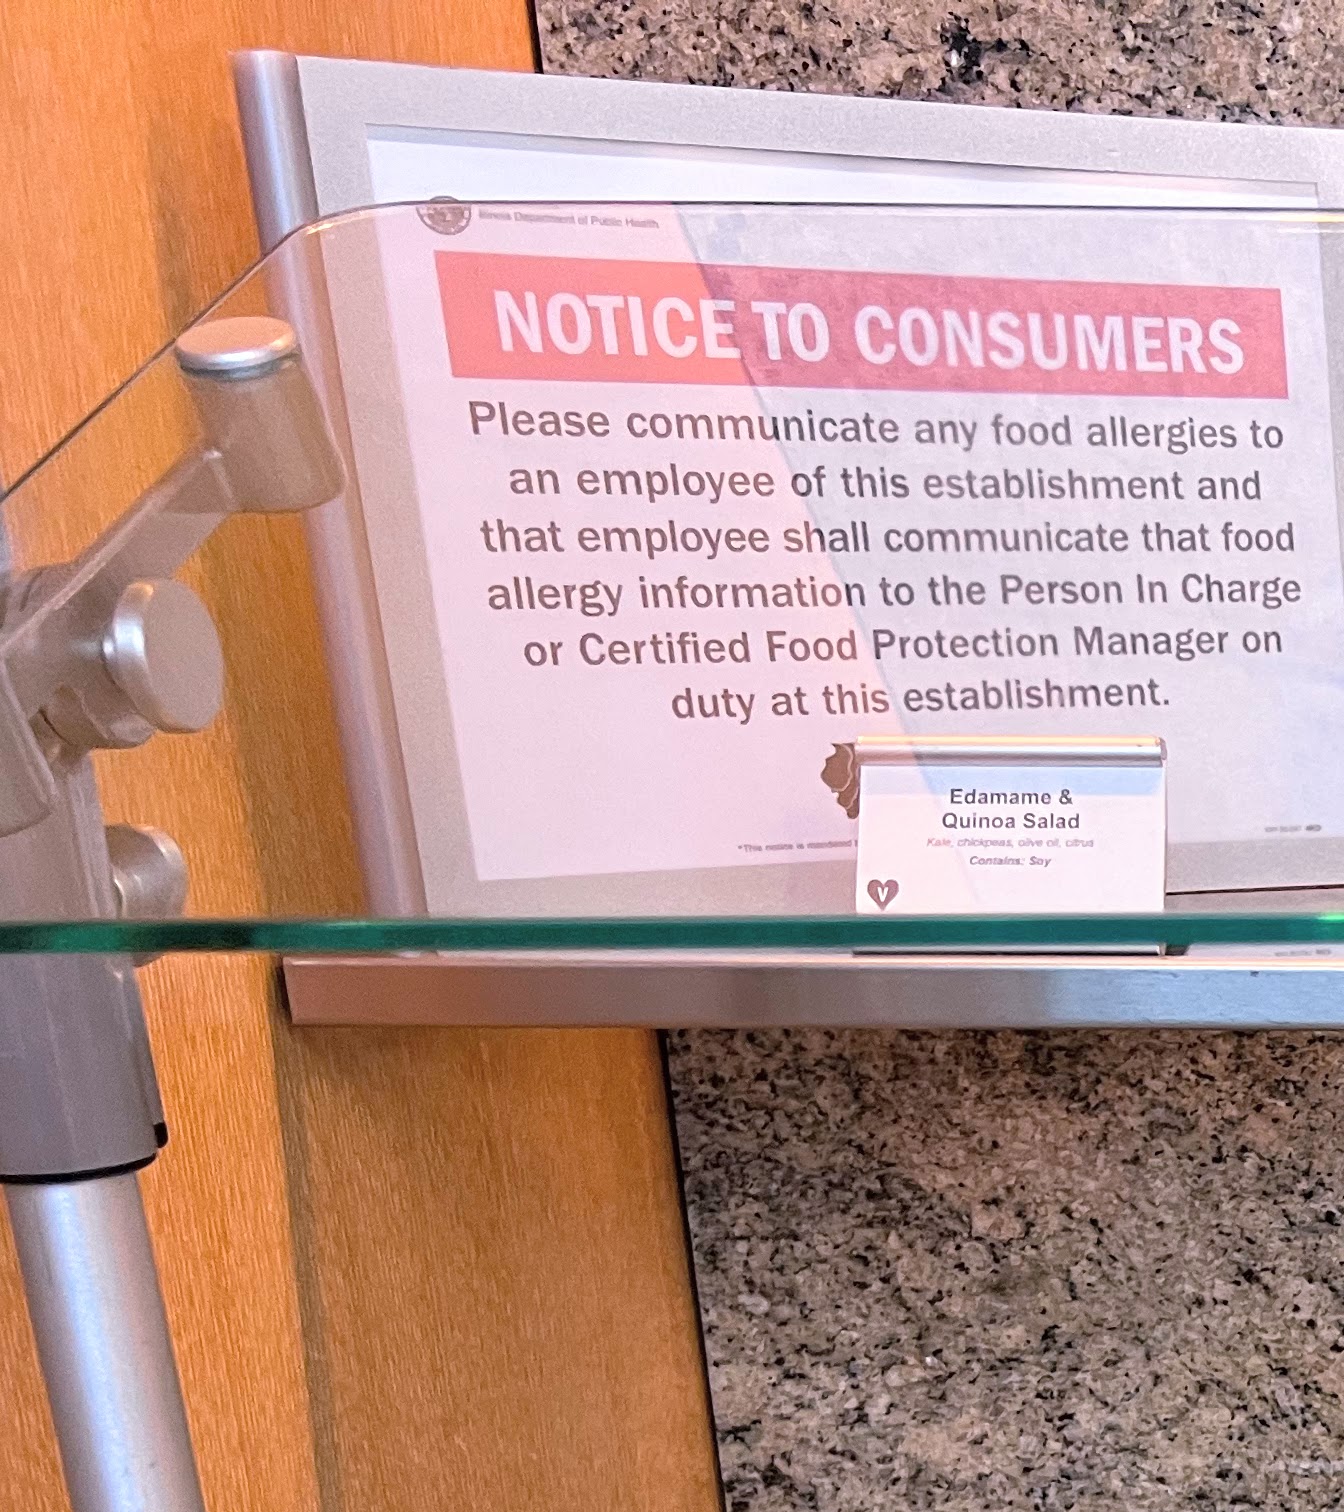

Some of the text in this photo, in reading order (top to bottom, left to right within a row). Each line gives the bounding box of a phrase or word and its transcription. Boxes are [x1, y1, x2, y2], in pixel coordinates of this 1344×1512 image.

[493, 288, 1245, 375] NOTICE TO CONSUMERS
[468, 400, 1285, 455] Please communicate any food allergies to
[509, 463, 1262, 504] an employee of this establishment and
[479, 519, 1296, 560] that employee shall communicate that food
[487, 572, 1302, 617] allergy information to the Person In Charge
[523, 625, 1283, 667] or Certified Food Protection Manager on
[671, 678, 1171, 725] duty at this establishment.
[949, 788, 1074, 805] Edamame &
[941, 812, 1081, 830] Quinoa Salad
[1029, 856, 1052, 868] Soy
